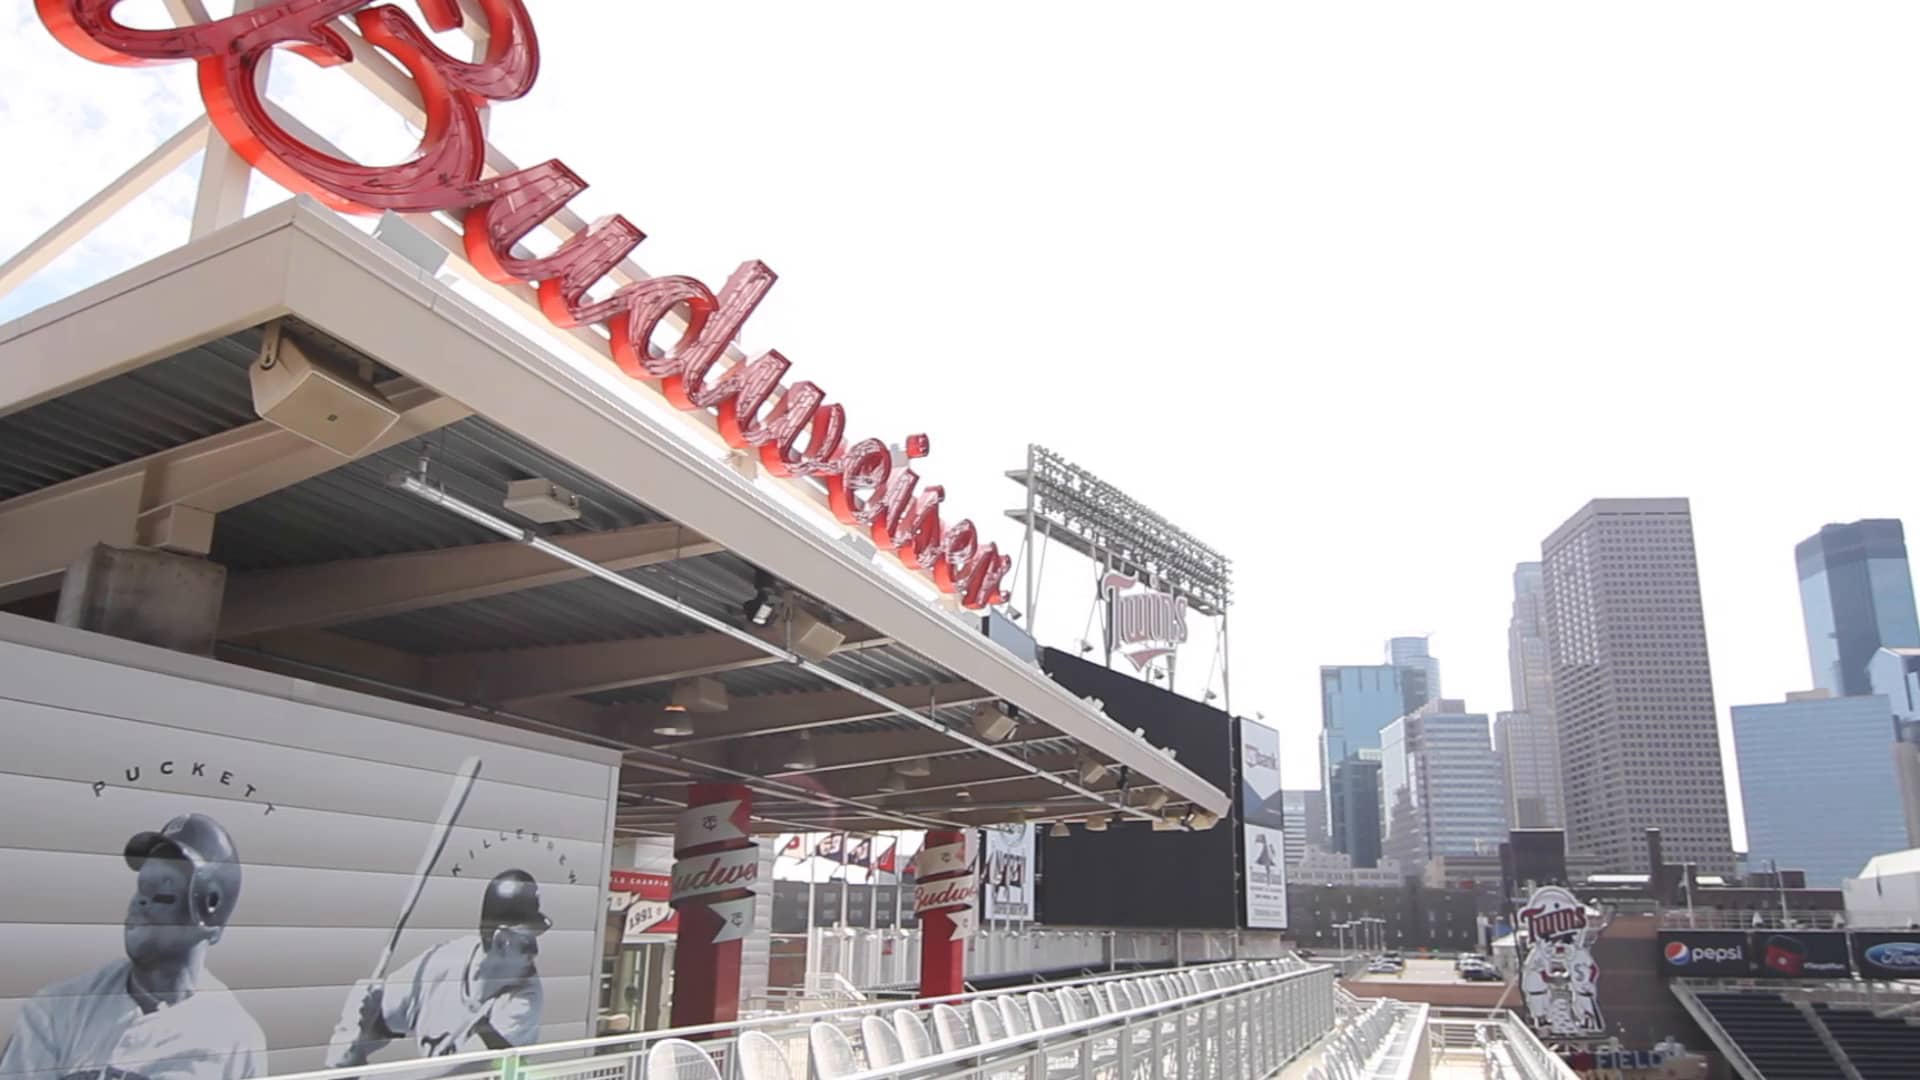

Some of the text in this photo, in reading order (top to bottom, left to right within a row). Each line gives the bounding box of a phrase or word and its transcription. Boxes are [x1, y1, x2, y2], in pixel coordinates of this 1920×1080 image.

[33, 0, 1013, 609] Budweiser
[1102, 570, 1188, 652] Twins
[92, 761, 276, 816] PUCKETT
[628, 907, 653, 930] 1991
[1519, 903, 1588, 944] Twins
[1692, 945, 1743, 963] pepsi
[1596, 1049, 1665, 1070] FIELD
